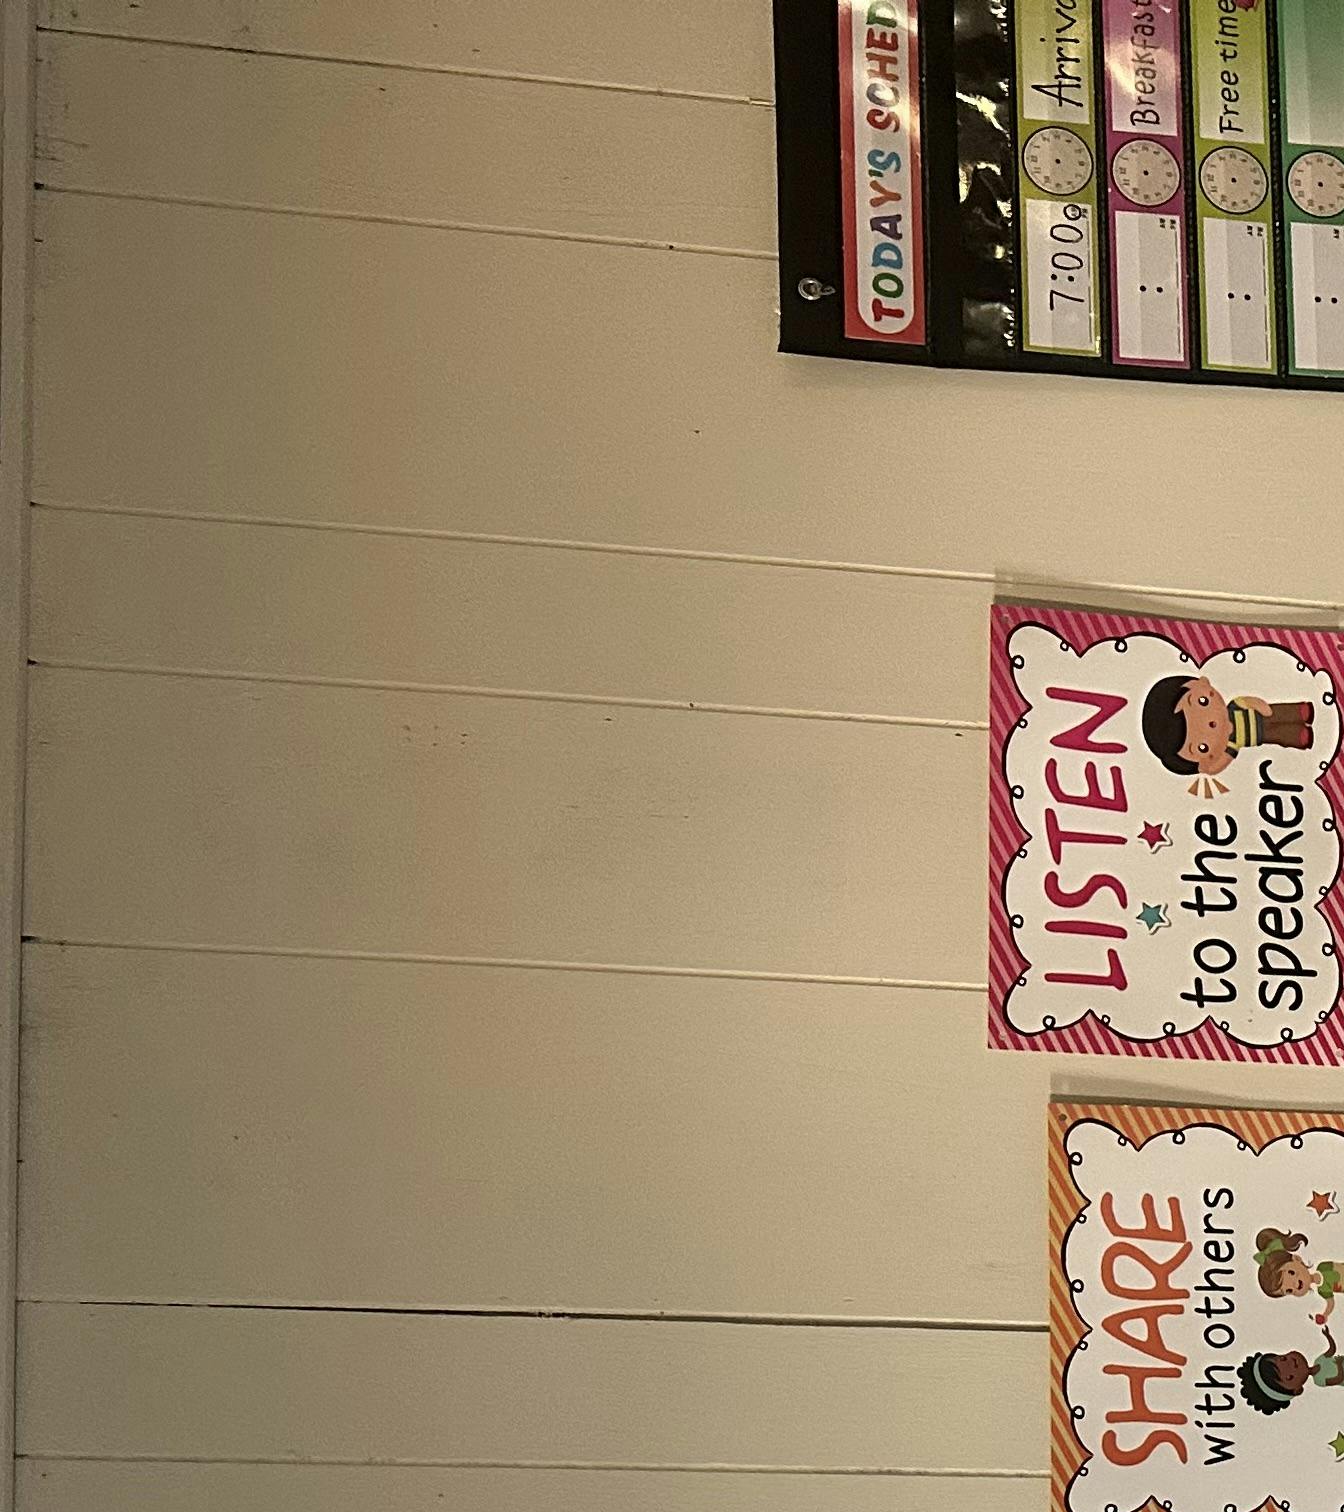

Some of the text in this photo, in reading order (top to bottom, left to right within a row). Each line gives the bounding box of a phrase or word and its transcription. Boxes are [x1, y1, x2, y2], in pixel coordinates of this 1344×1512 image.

[865, 0, 904, 321] TODAY'S SCHED
[1215, 0, 1244, 133] Free time
[1049, 223, 1084, 311] 7:00
[1044, 686, 1130, 991] LISTEN
[1180, 813, 1238, 1008] to the
[1244, 759, 1318, 1011] speaker
[1100, 1191, 1193, 1467] SHARE
[1194, 1187, 1237, 1466] with others
